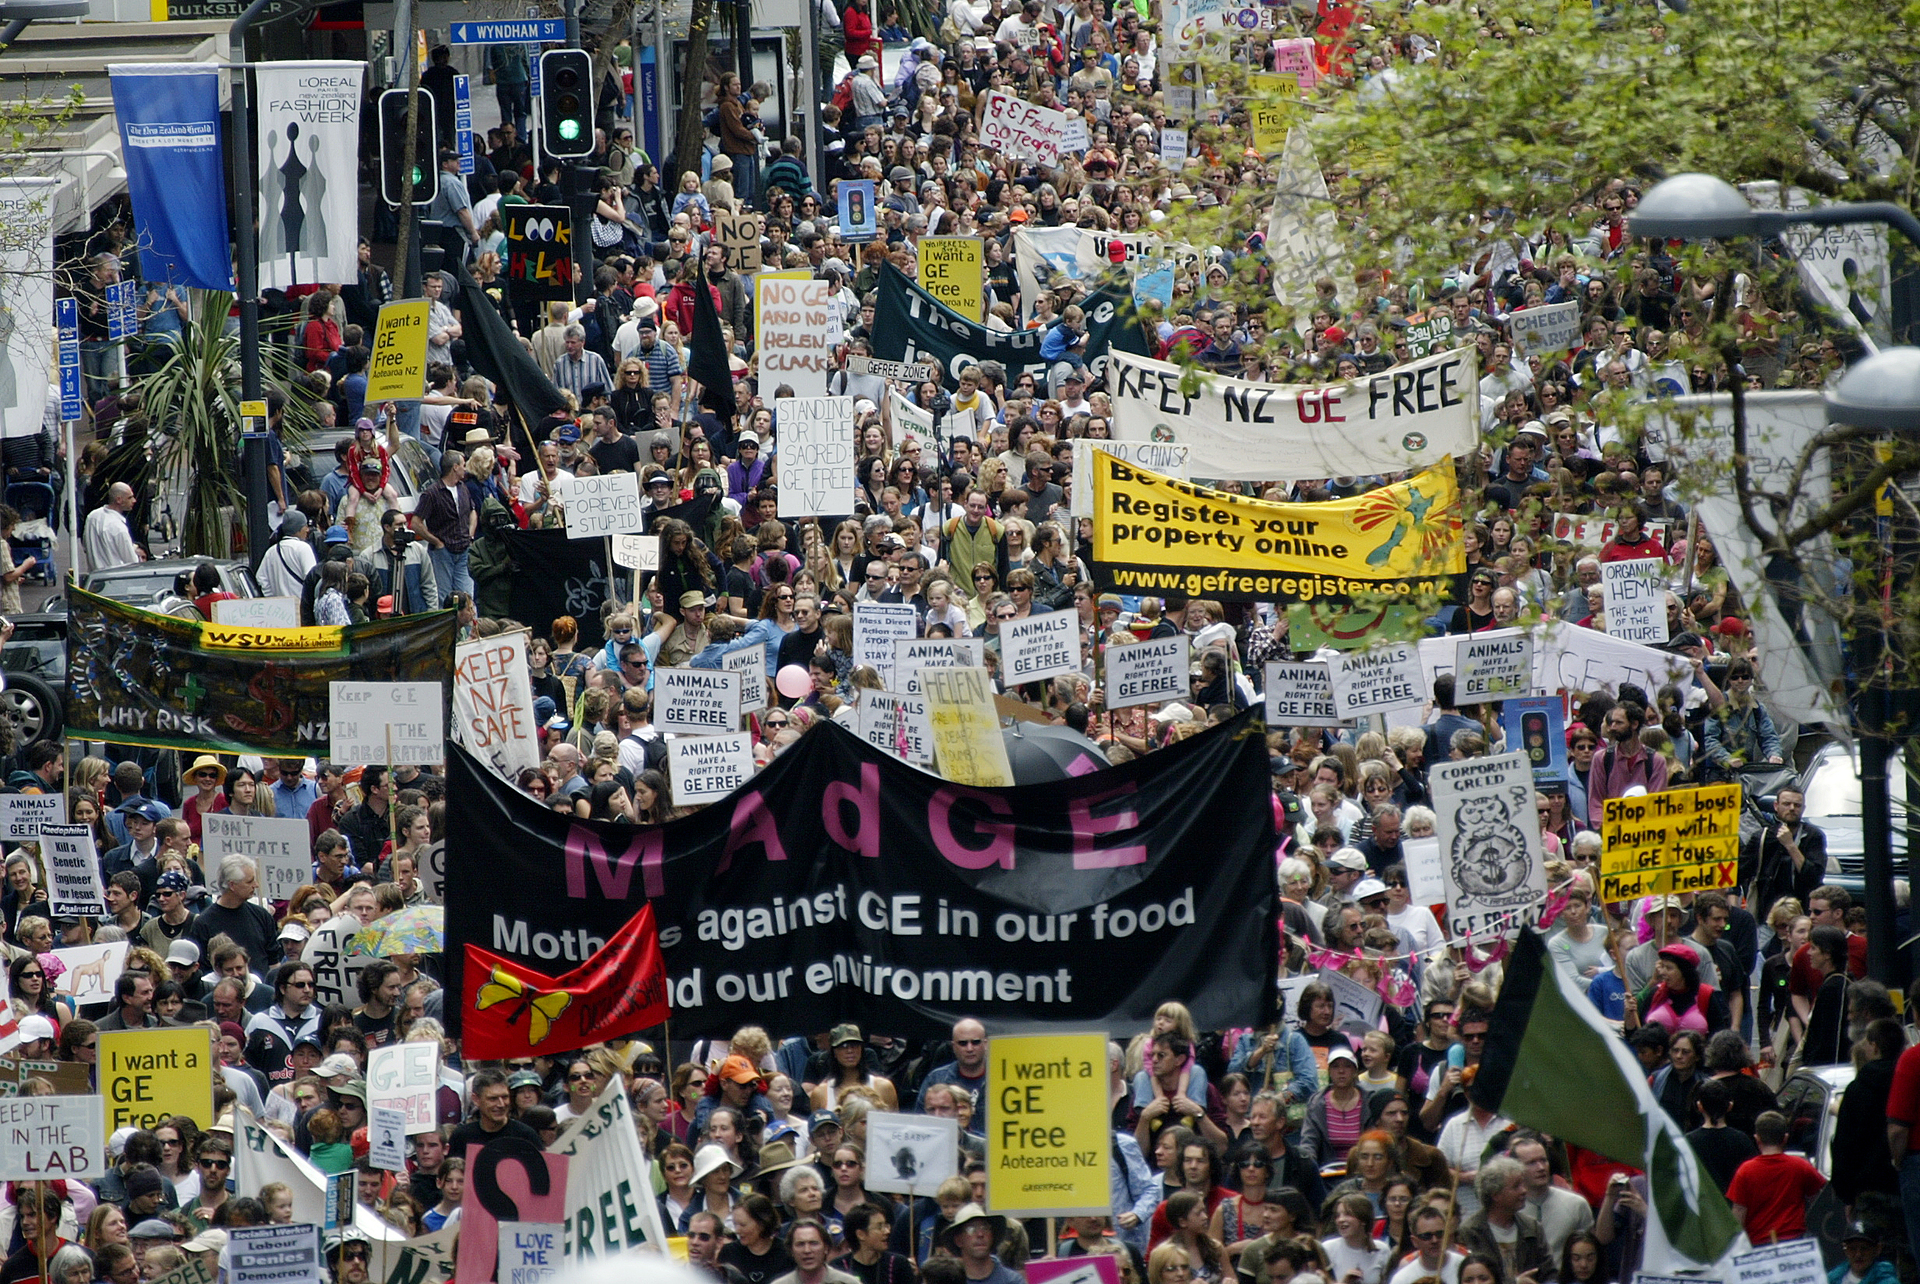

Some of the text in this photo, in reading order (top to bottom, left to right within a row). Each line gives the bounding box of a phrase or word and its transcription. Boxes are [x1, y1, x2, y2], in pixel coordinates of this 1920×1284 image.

[477, 23, 555, 39] WYNDHAM ST
[458, 78, 464, 88] P
[270, 100, 356, 112] FASHION
[300, 112, 354, 123] WEEK
[130, 124, 212, 135] The New Zealand Herald
[1176, 135, 1185, 143] the
[722, 219, 756, 242] NO
[925, 250, 974, 261] I want a
[925, 264, 949, 278] GE
[925, 281, 960, 296] Free
[964, 299, 975, 307] NZ
[380, 314, 420, 331] I want a
[762, 310, 800, 325] AND
[806, 311, 826, 326] NO
[1514, 308, 1576, 332] CHEEKY
[1406, 317, 1450, 342] Say NO
[377, 331, 395, 349] GE
[764, 331, 825, 350] HELEN
[374, 350, 404, 368] Free
[765, 353, 828, 373] CLARK
[66, 369, 73, 379] P
[372, 366, 418, 379] Aotearoa NZ
[1223, 386, 1275, 424] NZ
[1297, 388, 1348, 424] GE
[1368, 358, 1463, 420] FREE
[779, 399, 852, 421] STANDING
[778, 421, 851, 443] FOR THE
[574, 476, 622, 495] DONE
[783, 467, 851, 490] GE FREE
[565, 495, 638, 514] FOREVER
[803, 491, 826, 513] NZ
[1112, 492, 1241, 525] Register
[1251, 518, 1319, 535] your
[580, 513, 637, 533] STUPID
[1112, 524, 1349, 559] property online
[1611, 578, 1661, 600] HEMP
[1609, 605, 1655, 616] THE WAY
[859, 617, 882, 625] Mass
[1615, 618, 1627, 626] OF
[865, 651, 887, 659] STAY
[1341, 651, 1407, 673] ANIMALS
[454, 646, 514, 686] KEEP
[1472, 665, 1506, 675] RIGHT TO
[666, 675, 729, 689] ANIMALS
[923, 670, 986, 705] HELEN
[1351, 674, 1405, 690] RIGHT TO BE
[337, 686, 418, 703] KEEP GE
[470, 678, 515, 715] NZ
[672, 698, 696, 707] RIGHT
[683, 690, 704, 698] HAVE
[1347, 683, 1414, 706] GE FREE
[98, 706, 216, 734] WHY RISK
[666, 709, 727, 724] GE FREE
[335, 722, 427, 738] IN THE
[472, 708, 527, 748] SAFE
[1441, 758, 1521, 781] CORPORATE
[1453, 774, 1505, 791] GREED
[1606, 791, 1735, 823] Stop the boys
[41, 825, 88, 836] Paedophiles
[208, 817, 254, 837] DON'T
[1608, 814, 1717, 852] playing with
[55, 842, 68, 852] Kill
[221, 839, 290, 856] MUTATE
[1638, 843, 1715, 868] GE toys
[53, 857, 86, 868] Genetic
[55, 873, 91, 885] Engineer
[265, 865, 305, 882] FOOD
[1604, 867, 1715, 899] Med Field
[71, 890, 95, 900] Jesus
[58, 904, 89, 914] Against
[492, 883, 1195, 962] Moths against GE in our food
[715, 966, 794, 1002] our
[805, 952, 1073, 1002] environment
[111, 1050, 197, 1071] I want a
[1001, 1057, 1092, 1080] I want a
[111, 1075, 153, 1103] GE
[1001, 1085, 1044, 1114] GE
[11, 1125, 72, 1145] IN THE
[1002, 1121, 1066, 1149] Free
[26, 1147, 89, 1174] LAB
[1001, 1151, 1098, 1170] Aotearoa NZ
[233, 1225, 312, 1240] Socialist Worker
[515, 1233, 554, 1249] LOVE
[248, 1239, 298, 1251] Labour
[240, 1251, 305, 1267] Denies
[523, 1251, 548, 1265] ME
[1778, 1259, 1816, 1273] Direct
[237, 1268, 310, 1282] Democracy
